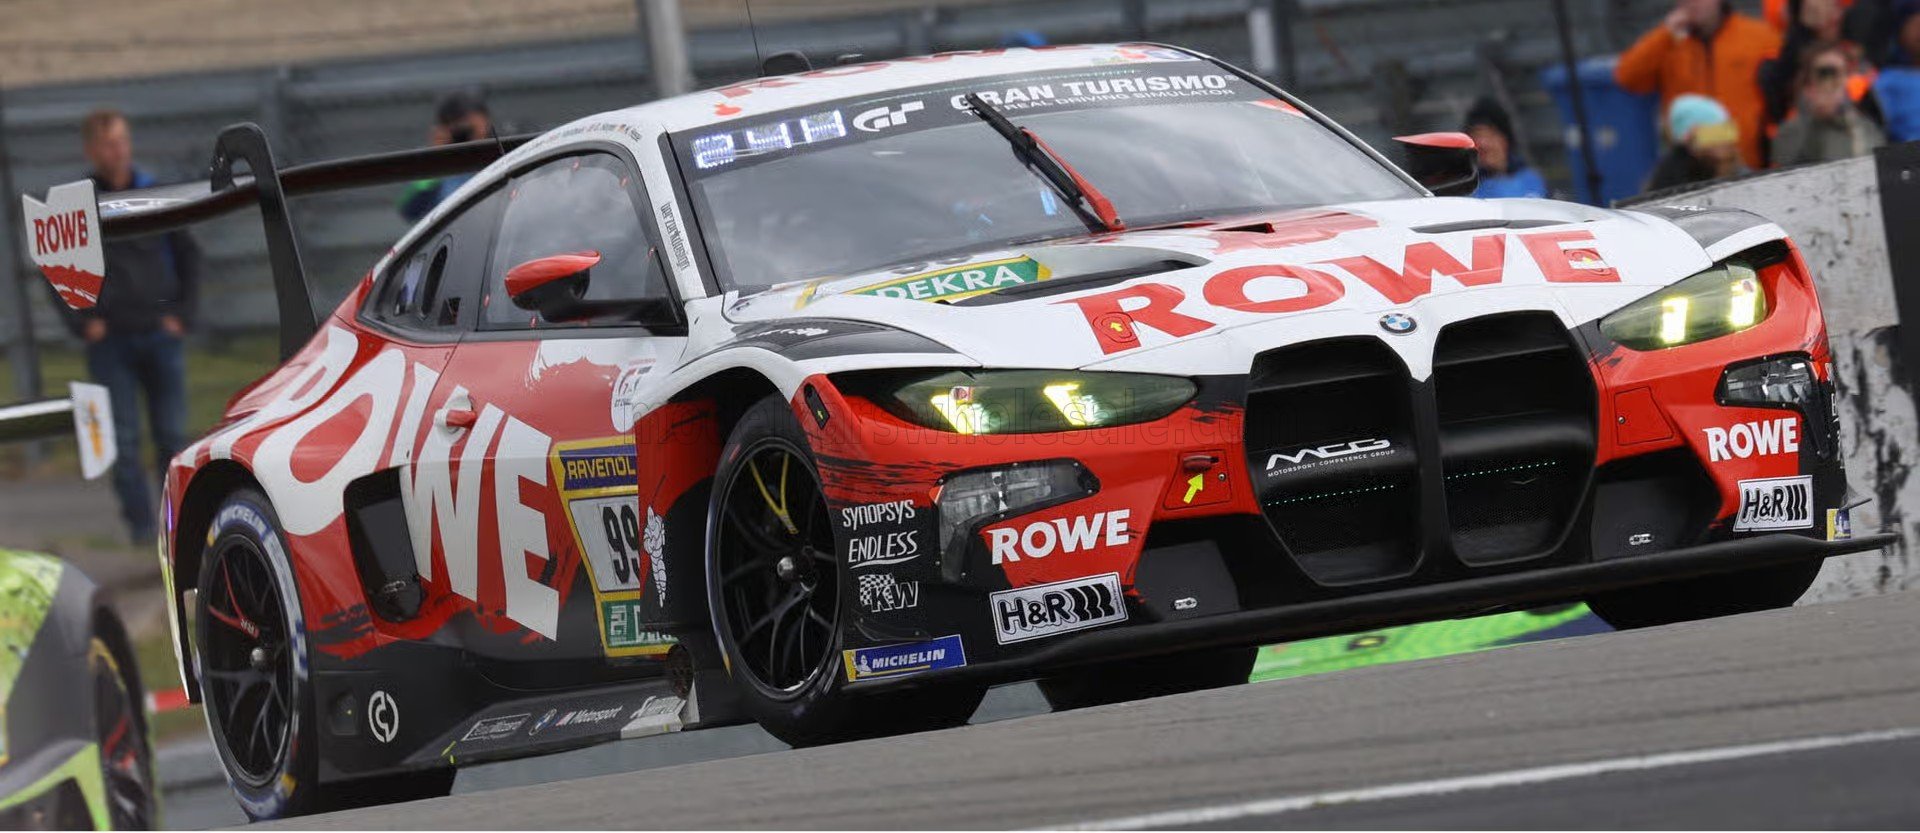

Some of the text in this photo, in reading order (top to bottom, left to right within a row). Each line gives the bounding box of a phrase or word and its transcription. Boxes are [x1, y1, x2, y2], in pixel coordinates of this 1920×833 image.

[951, 84, 1055, 110] GRAN
[1055, 92, 1130, 105] DRIVING
[1132, 88, 1235, 99] SIMULATOR
[33, 209, 89, 255] ROWE
[876, 265, 1025, 300] DEKRA
[1050, 230, 1622, 355] ROWE
[1702, 417, 1799, 463] ROWE
[566, 457, 637, 480] RAVENOL
[1267, 449, 1396, 477] MOTORSPORT COMPETENCE GROUP
[180, 325, 560, 642] ROWE
[842, 499, 916, 530] SYNOPSYS
[1741, 488, 1785, 520] H&R
[848, 530, 919, 563] ENDLESS
[986, 508, 1131, 565] ROWE
[870, 580, 919, 613] KW
[999, 592, 1072, 631] H&R
[872, 648, 946, 669] MICHELIN
